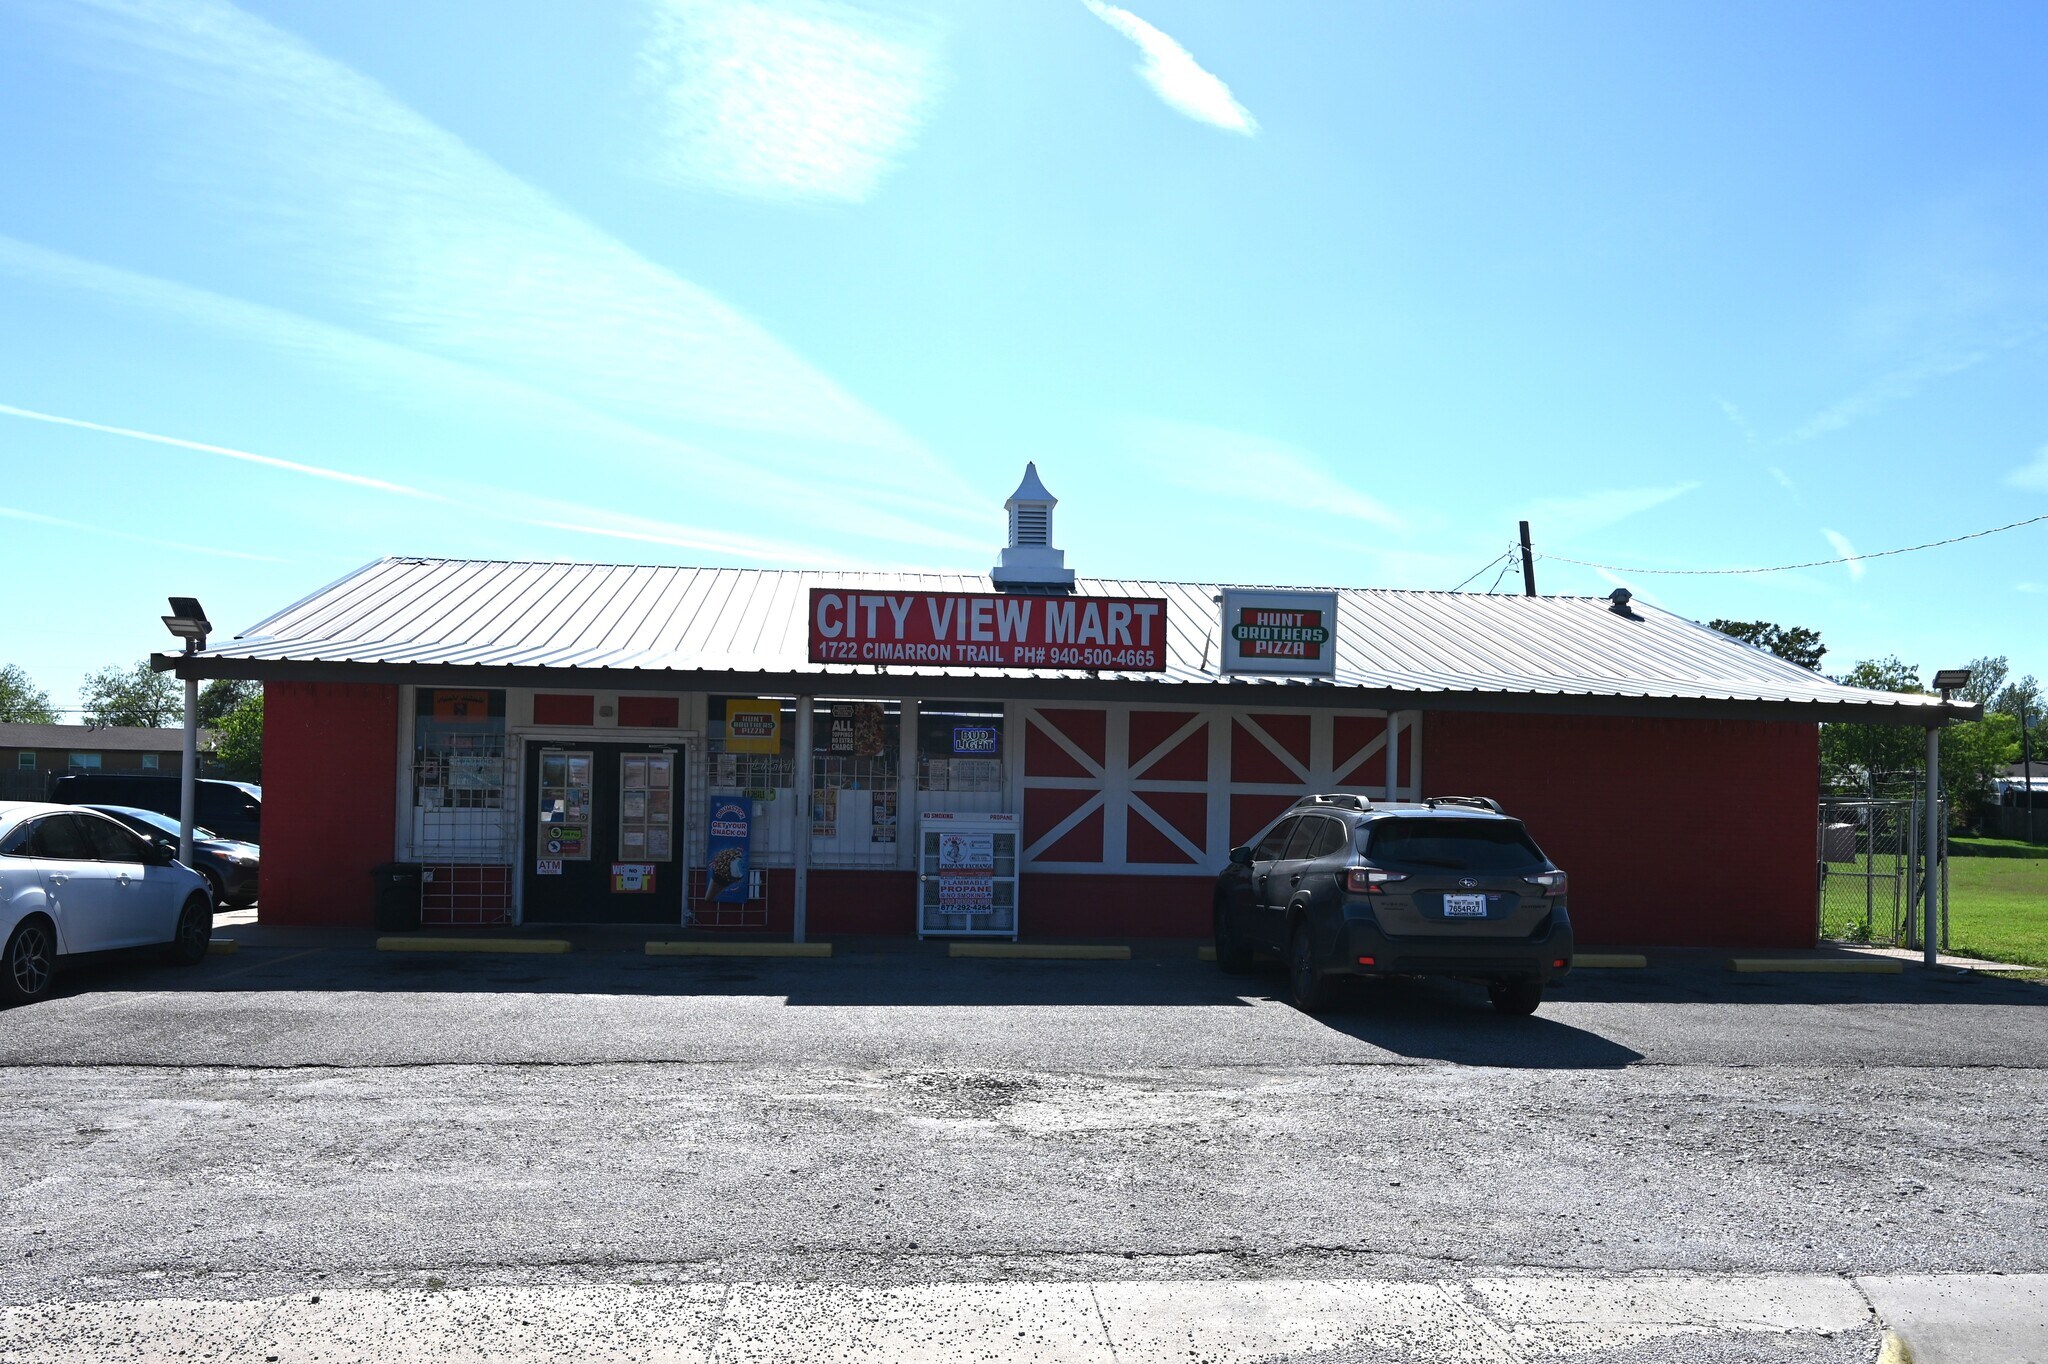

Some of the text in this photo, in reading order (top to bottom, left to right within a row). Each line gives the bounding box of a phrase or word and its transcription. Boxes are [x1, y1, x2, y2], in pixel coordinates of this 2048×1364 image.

[816, 593, 1159, 647] CITY VIEW MART
[1257, 612, 1304, 627] HUNT
[1237, 626, 1323, 641] BROTHERS
[1255, 640, 1305, 656] PIZZA
[819, 641, 1155, 667] 1722 CIMARRON TRAIL PH# 940-500-4665
[831, 720, 853, 731] ALL
[961, 730, 989, 741] BUD
[831, 743, 853, 751] CHARGE
[955, 740, 994, 751] LIGHT
[712, 828, 736, 836] SNACK
[538, 861, 561, 870] ATM
[612, 864, 624, 875] WE
[1449, 904, 1481, 913] 7654R27
